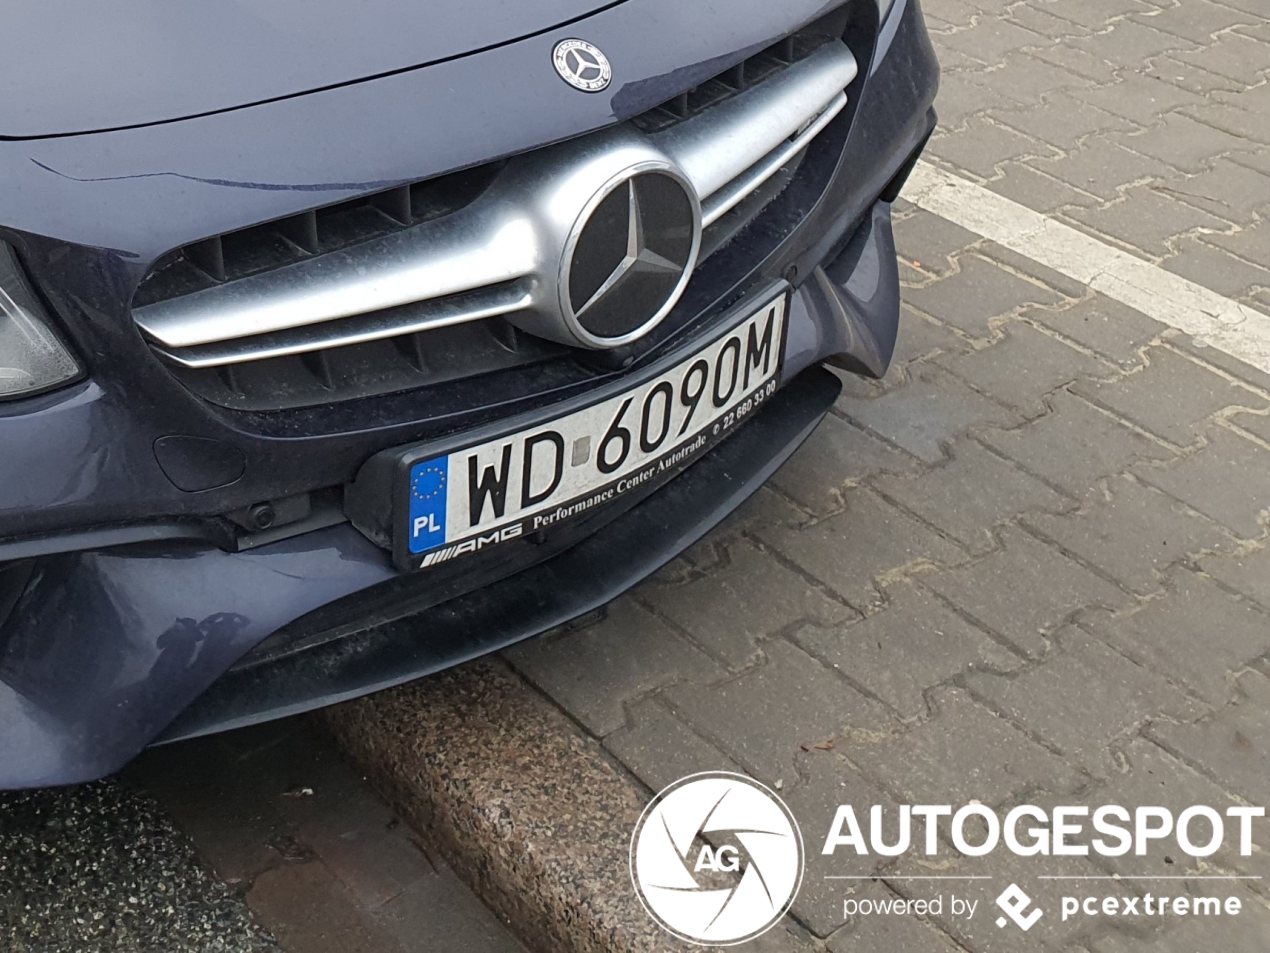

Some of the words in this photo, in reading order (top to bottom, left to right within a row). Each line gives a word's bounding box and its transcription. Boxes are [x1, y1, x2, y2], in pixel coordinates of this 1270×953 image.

[467, 430, 565, 528] WD
[596, 306, 776, 475] 6090M
[533, 488, 614, 530] Performance
[616, 467, 655, 494] Center
[656, 434, 707, 474] Autotrade
[723, 411, 735, 430] 22
[736, 398, 752, 419] 660
[753, 389, 764, 406] 33
[766, 379, 776, 396] 00
[413, 513, 441, 538] PL
